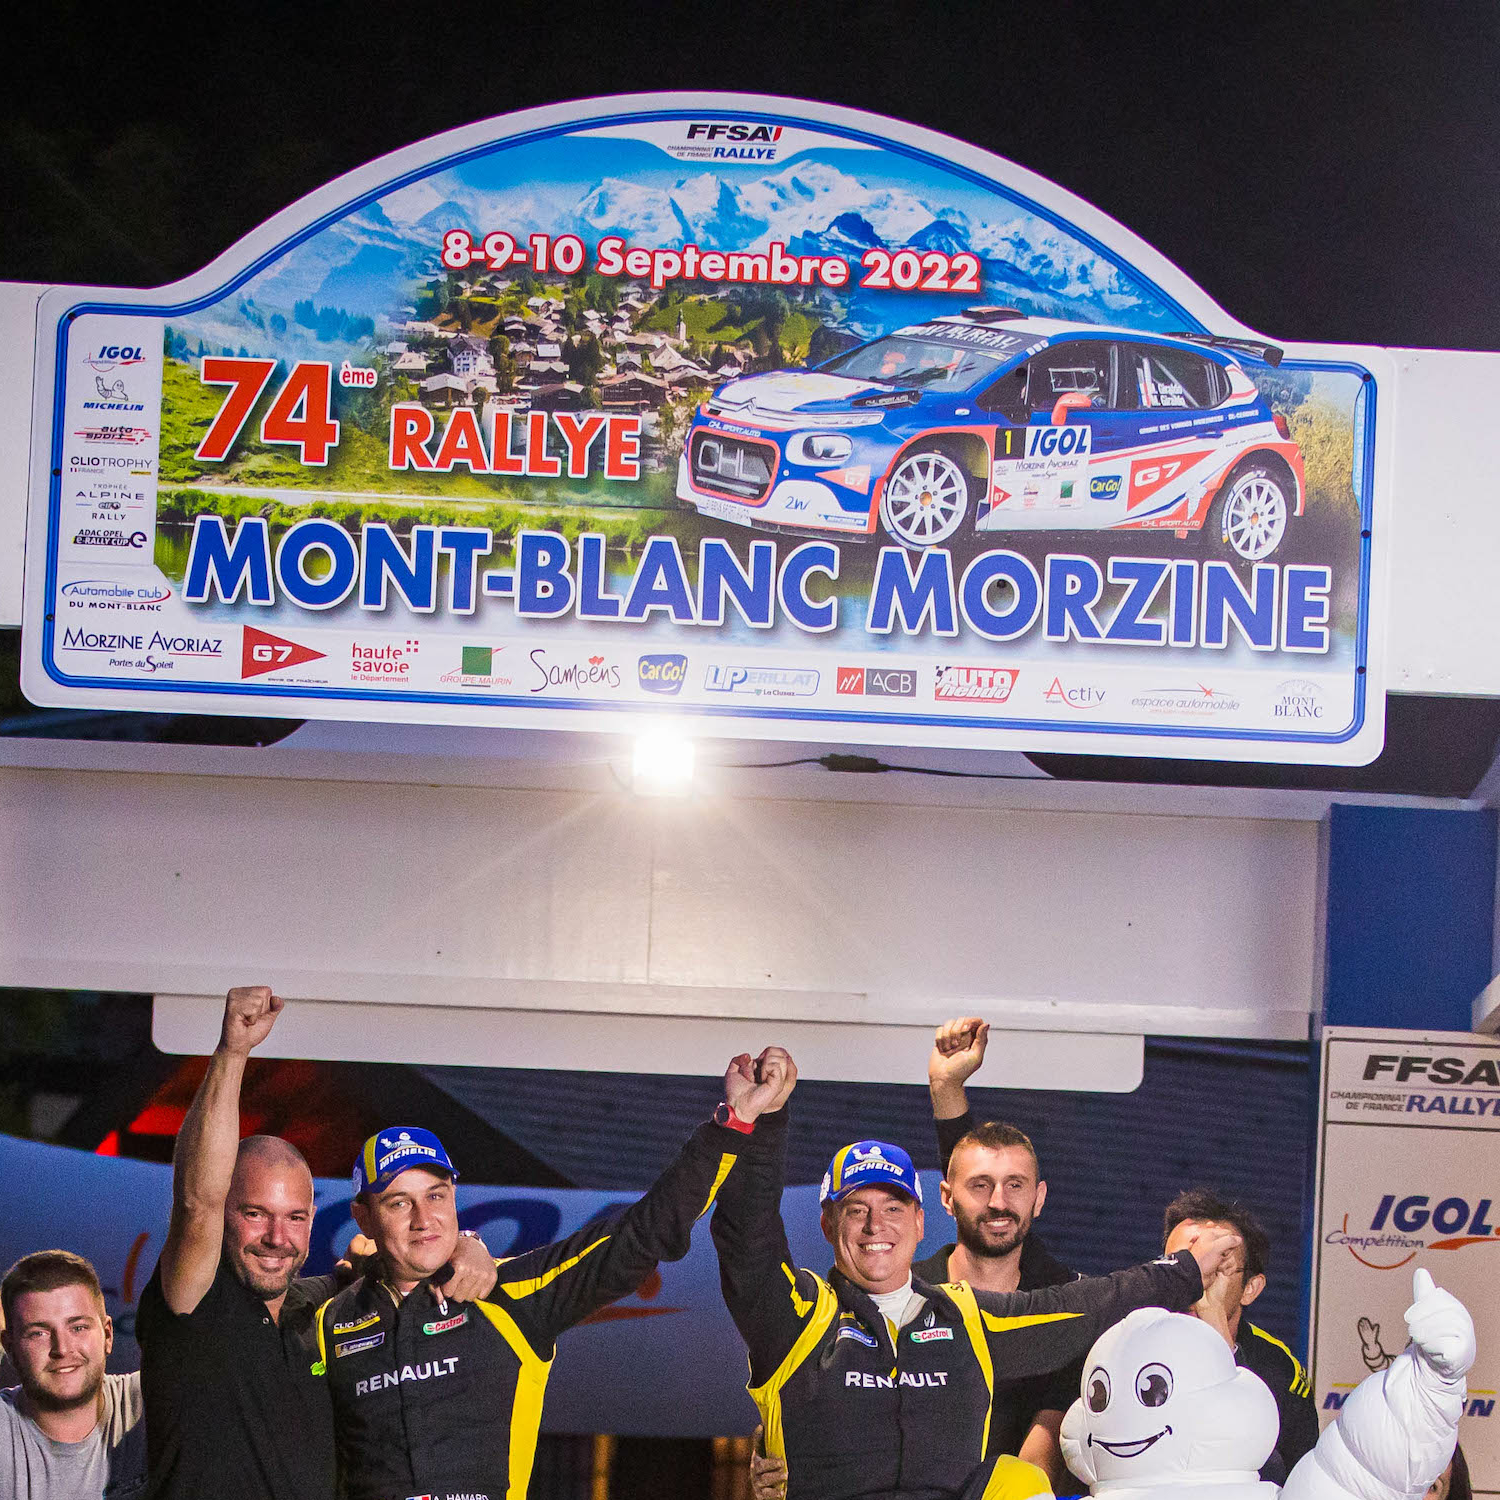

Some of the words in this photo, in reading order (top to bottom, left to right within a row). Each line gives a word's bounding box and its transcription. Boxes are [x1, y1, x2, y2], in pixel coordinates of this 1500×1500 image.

[687, 124, 771, 142] FFSA
[713, 147, 777, 160] RALLYE
[442, 229, 585, 273] 8-9-10
[596, 236, 850, 289] Septembre
[860, 248, 982, 293] 2022
[83, 402, 144, 411] MICHELIN
[85, 432, 125, 441] sport
[100, 425, 134, 433] auto
[389, 403, 643, 480] RALLYE
[1003, 430, 1013, 455] 1
[1029, 428, 1088, 457] IGOL
[1133, 462, 1182, 488] G7
[75, 491, 145, 500] ALPINE
[78, 529, 100, 537] ADAC
[111, 537, 130, 546] CUP
[70, 584, 135, 598] Automobile
[137, 586, 163, 599] Club
[182, 514, 840, 634] MONT-BLANC
[865, 546, 1333, 655] MORZINE
[69, 601, 85, 609] DU
[88, 602, 162, 612] MONT-BLANC
[62, 626, 143, 650] MORZINE
[148, 630, 223, 654] AVORIAZ
[252, 644, 293, 662] G7
[351, 642, 403, 662] haute
[108, 657, 132, 668] Portes
[134, 659, 146, 668] du
[351, 660, 410, 674] savoie
[359, 674, 409, 684] Département
[439, 674, 476, 685] GROUPE
[478, 676, 513, 686] MAURIN
[872, 671, 912, 694] ACB
[943, 668, 1011, 688] AUTO
[940, 683, 1012, 702] hebdo
[1131, 697, 1174, 710] espace
[1176, 697, 1240, 711] automobile
[1282, 696, 1317, 707] MONT
[1274, 705, 1324, 718] BLANC
[1363, 1054, 1500, 1087] FFSA
[1330, 1091, 1408, 1102] CHAMPIONNAT
[1345, 1101, 1360, 1111] DE
[1361, 1102, 1405, 1113] FRANCE
[379, 1147, 437, 1171] MICHELIN
[843, 1162, 904, 1179] MICHELIN
[1325, 1229, 1425, 1251] Compétition
[435, 1313, 465, 1332] Castrol
[921, 1329, 949, 1340] Castrol
[355, 1356, 459, 1397] RENAULT
[845, 1370, 949, 1389] RENAULT
